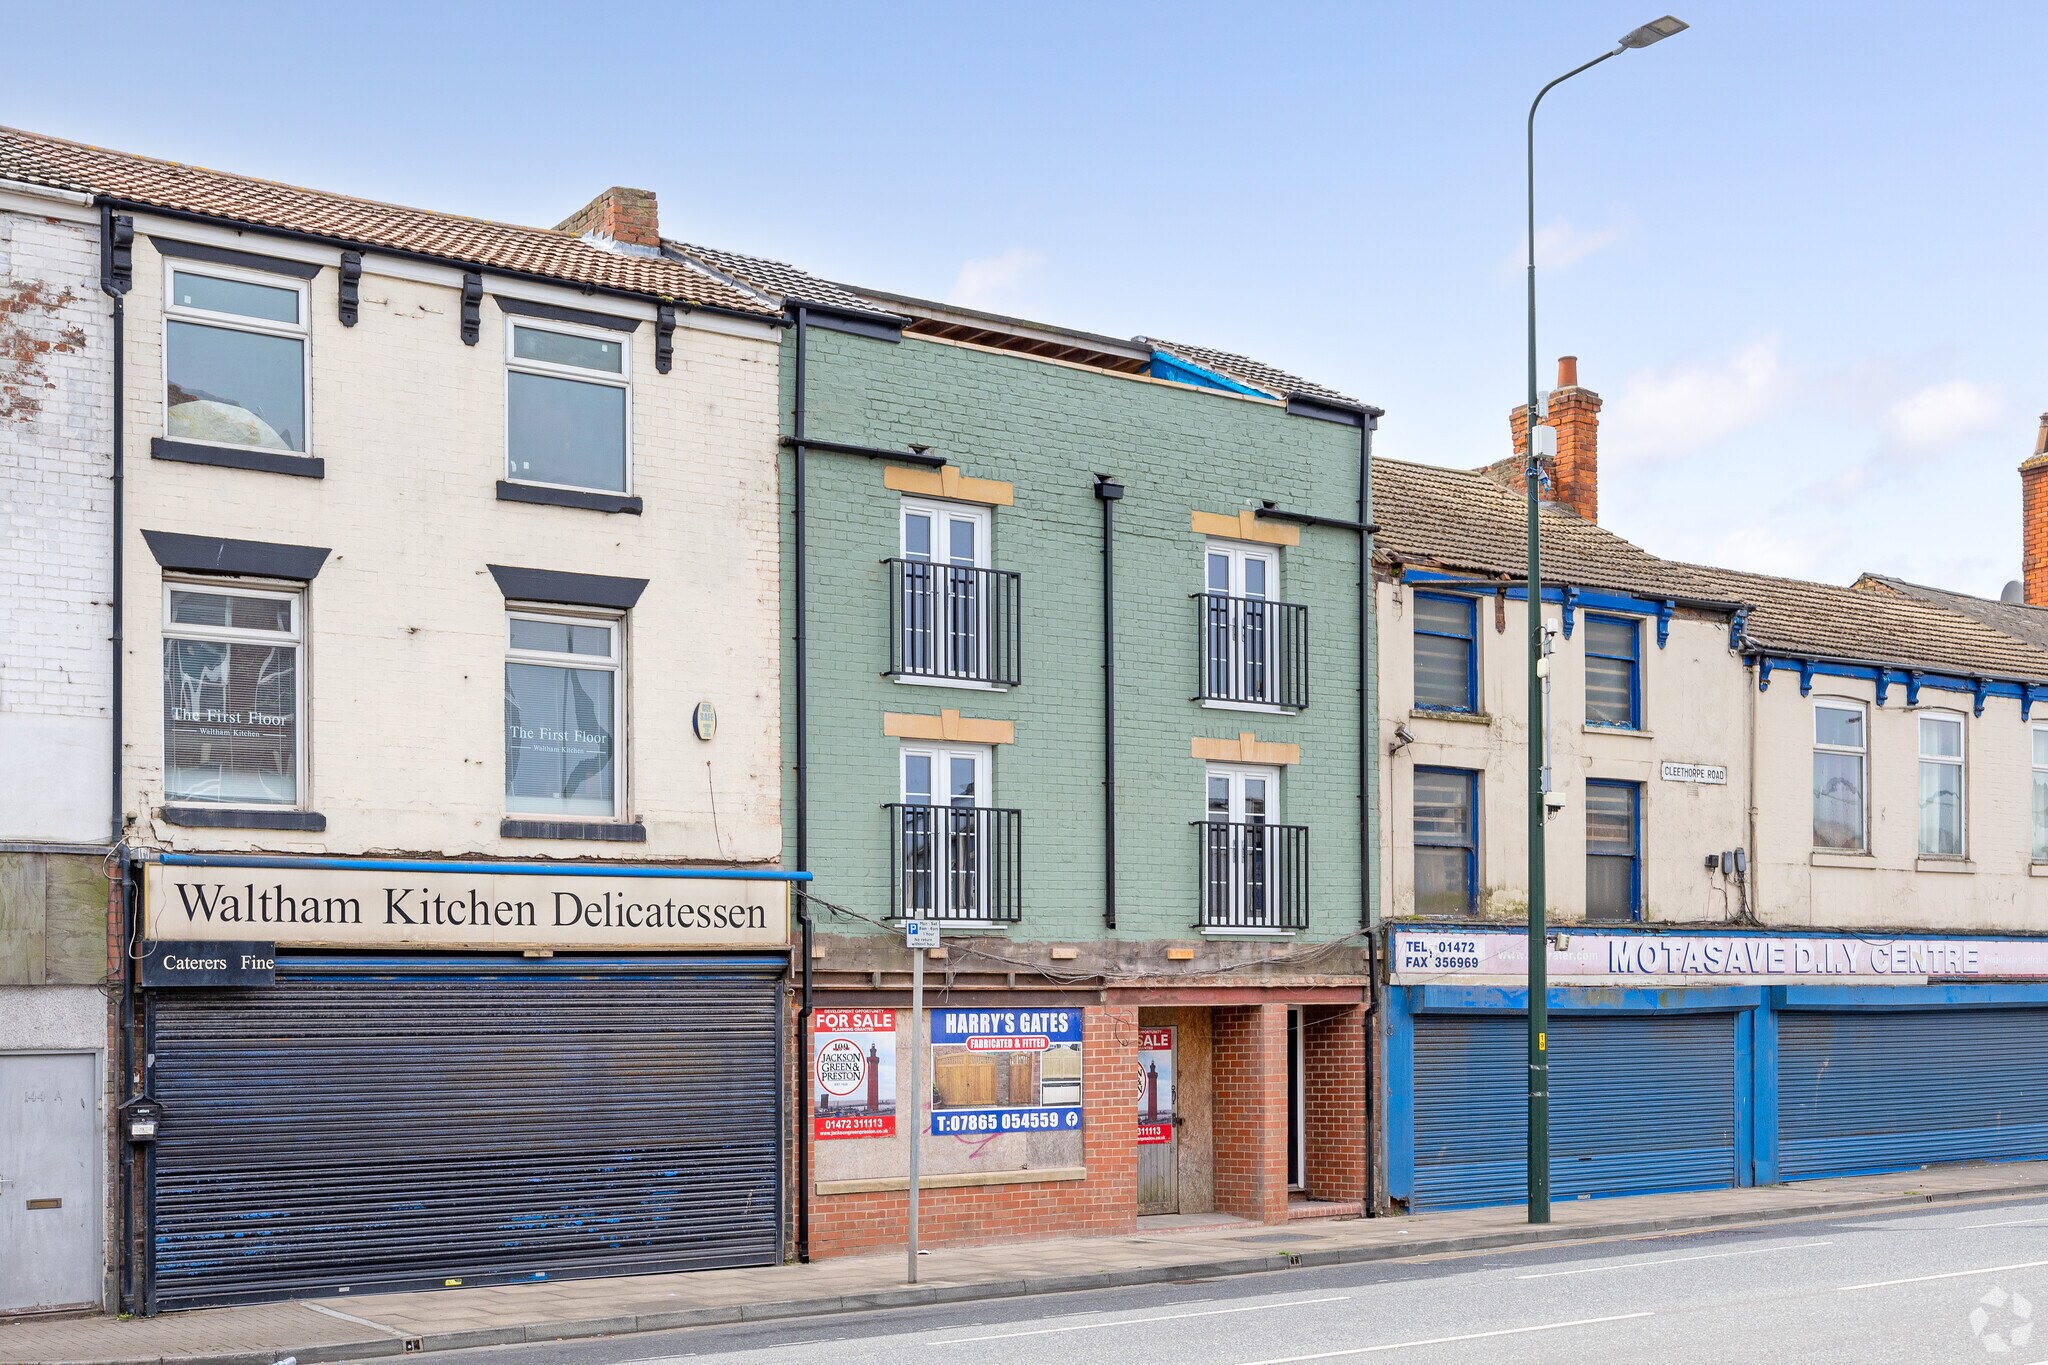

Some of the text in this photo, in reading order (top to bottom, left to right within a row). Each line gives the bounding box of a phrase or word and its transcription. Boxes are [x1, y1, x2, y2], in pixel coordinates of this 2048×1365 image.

[172, 707, 287, 726] The First Floor
[199, 728, 260, 737] Waltham Kitchen
[510, 726, 606, 744] The First Floor
[533, 745, 585, 754] Waltham Kitchen
[1665, 766, 1724, 780] CLEETHORPE ROAD
[174, 883, 768, 928] Waltham Kitchen Delicatessen
[1439, 942, 1475, 953] 01472
[163, 954, 275, 971] Caterers Fine
[1405, 957, 1479, 968] FAX 356969
[1609, 940, 1786, 974] MOTASAVE
[1795, 943, 1860, 974] D.I.Y
[1870, 944, 1979, 974] CENTRE
[816, 1014, 892, 1028] FOR SALE
[945, 1012, 1069, 1034] HARRY'S GATES
[970, 1038, 1045, 1049] FABRICATED & FITTED
[821, 1053, 860, 1063] JACKSON
[821, 1072, 860, 1081] PRESTON
[825, 1118, 883, 1130] 01472 311113
[937, 1112, 1059, 1131] T:07865 054559
[819, 1128, 889, 1136] www.jacksongreenpreston.co.uk
